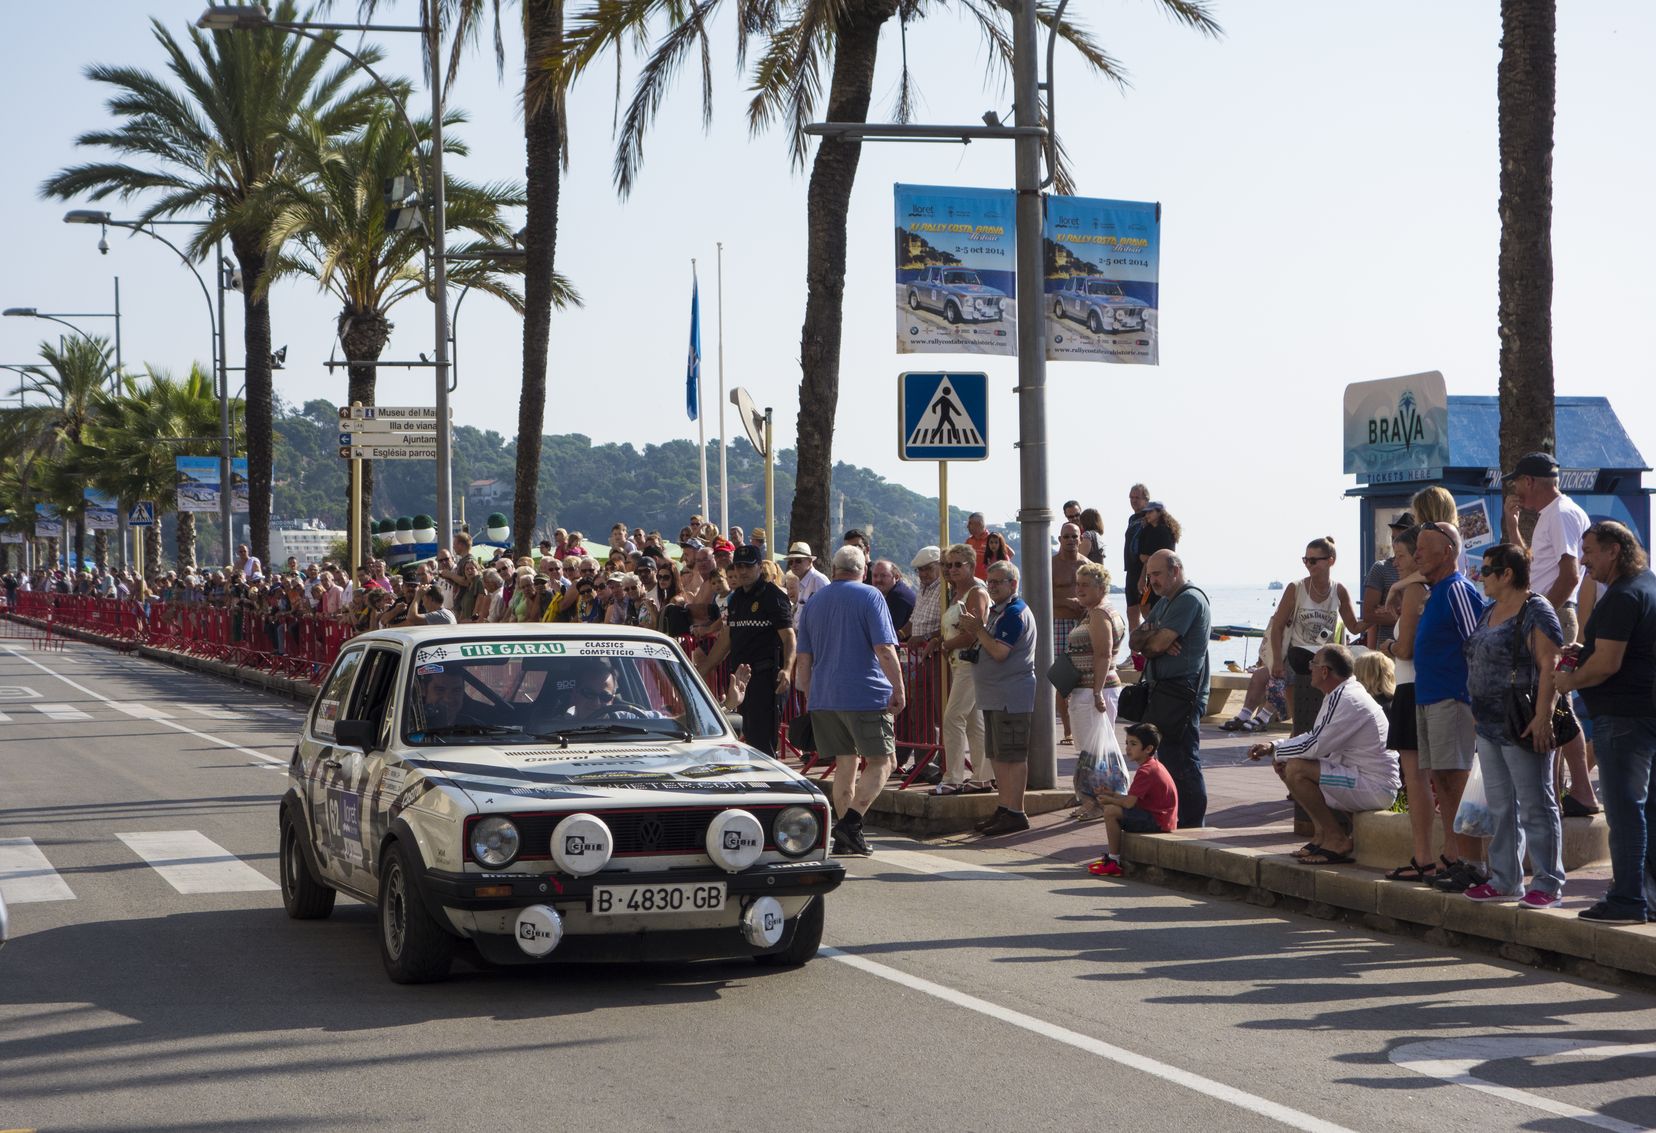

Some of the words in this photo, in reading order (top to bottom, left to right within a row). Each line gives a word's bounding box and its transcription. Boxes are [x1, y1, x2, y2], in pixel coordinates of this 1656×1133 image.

[920, 223, 947, 232] RALLY
[948, 224, 973, 233] COSTA
[975, 226, 1004, 235] BRAVA
[1067, 235, 1092, 244] RALLY
[1093, 235, 1117, 245] COSTA
[1119, 237, 1148, 247] BRAVA
[955, 246, 969, 254] 2-5
[985, 248, 1005, 256] 2014
[1099, 258, 1112, 267] 2-5
[1113, 257, 1128, 265] oct
[1129, 259, 1149, 267] 2014
[378, 408, 406, 417] Museu
[408, 408, 421, 417] del
[389, 421, 402, 430] Illa
[403, 421, 415, 430] de
[416, 421, 437, 430] viana
[1368, 408, 1425, 451] BRAVA
[402, 435, 437, 446] Ajuntam
[372, 448, 407, 458] Església
[408, 449, 436, 459] parroq
[1367, 471, 1404, 483] TICKETS
[1408, 469, 1432, 479] HERE
[1559, 471, 1596, 489] TICKETS
[463, 645, 495, 656] TIR
[499, 643, 563, 655] GARAU
[584, 641, 625, 649] CLASSICS
[524, 755, 589, 763] Castrol
